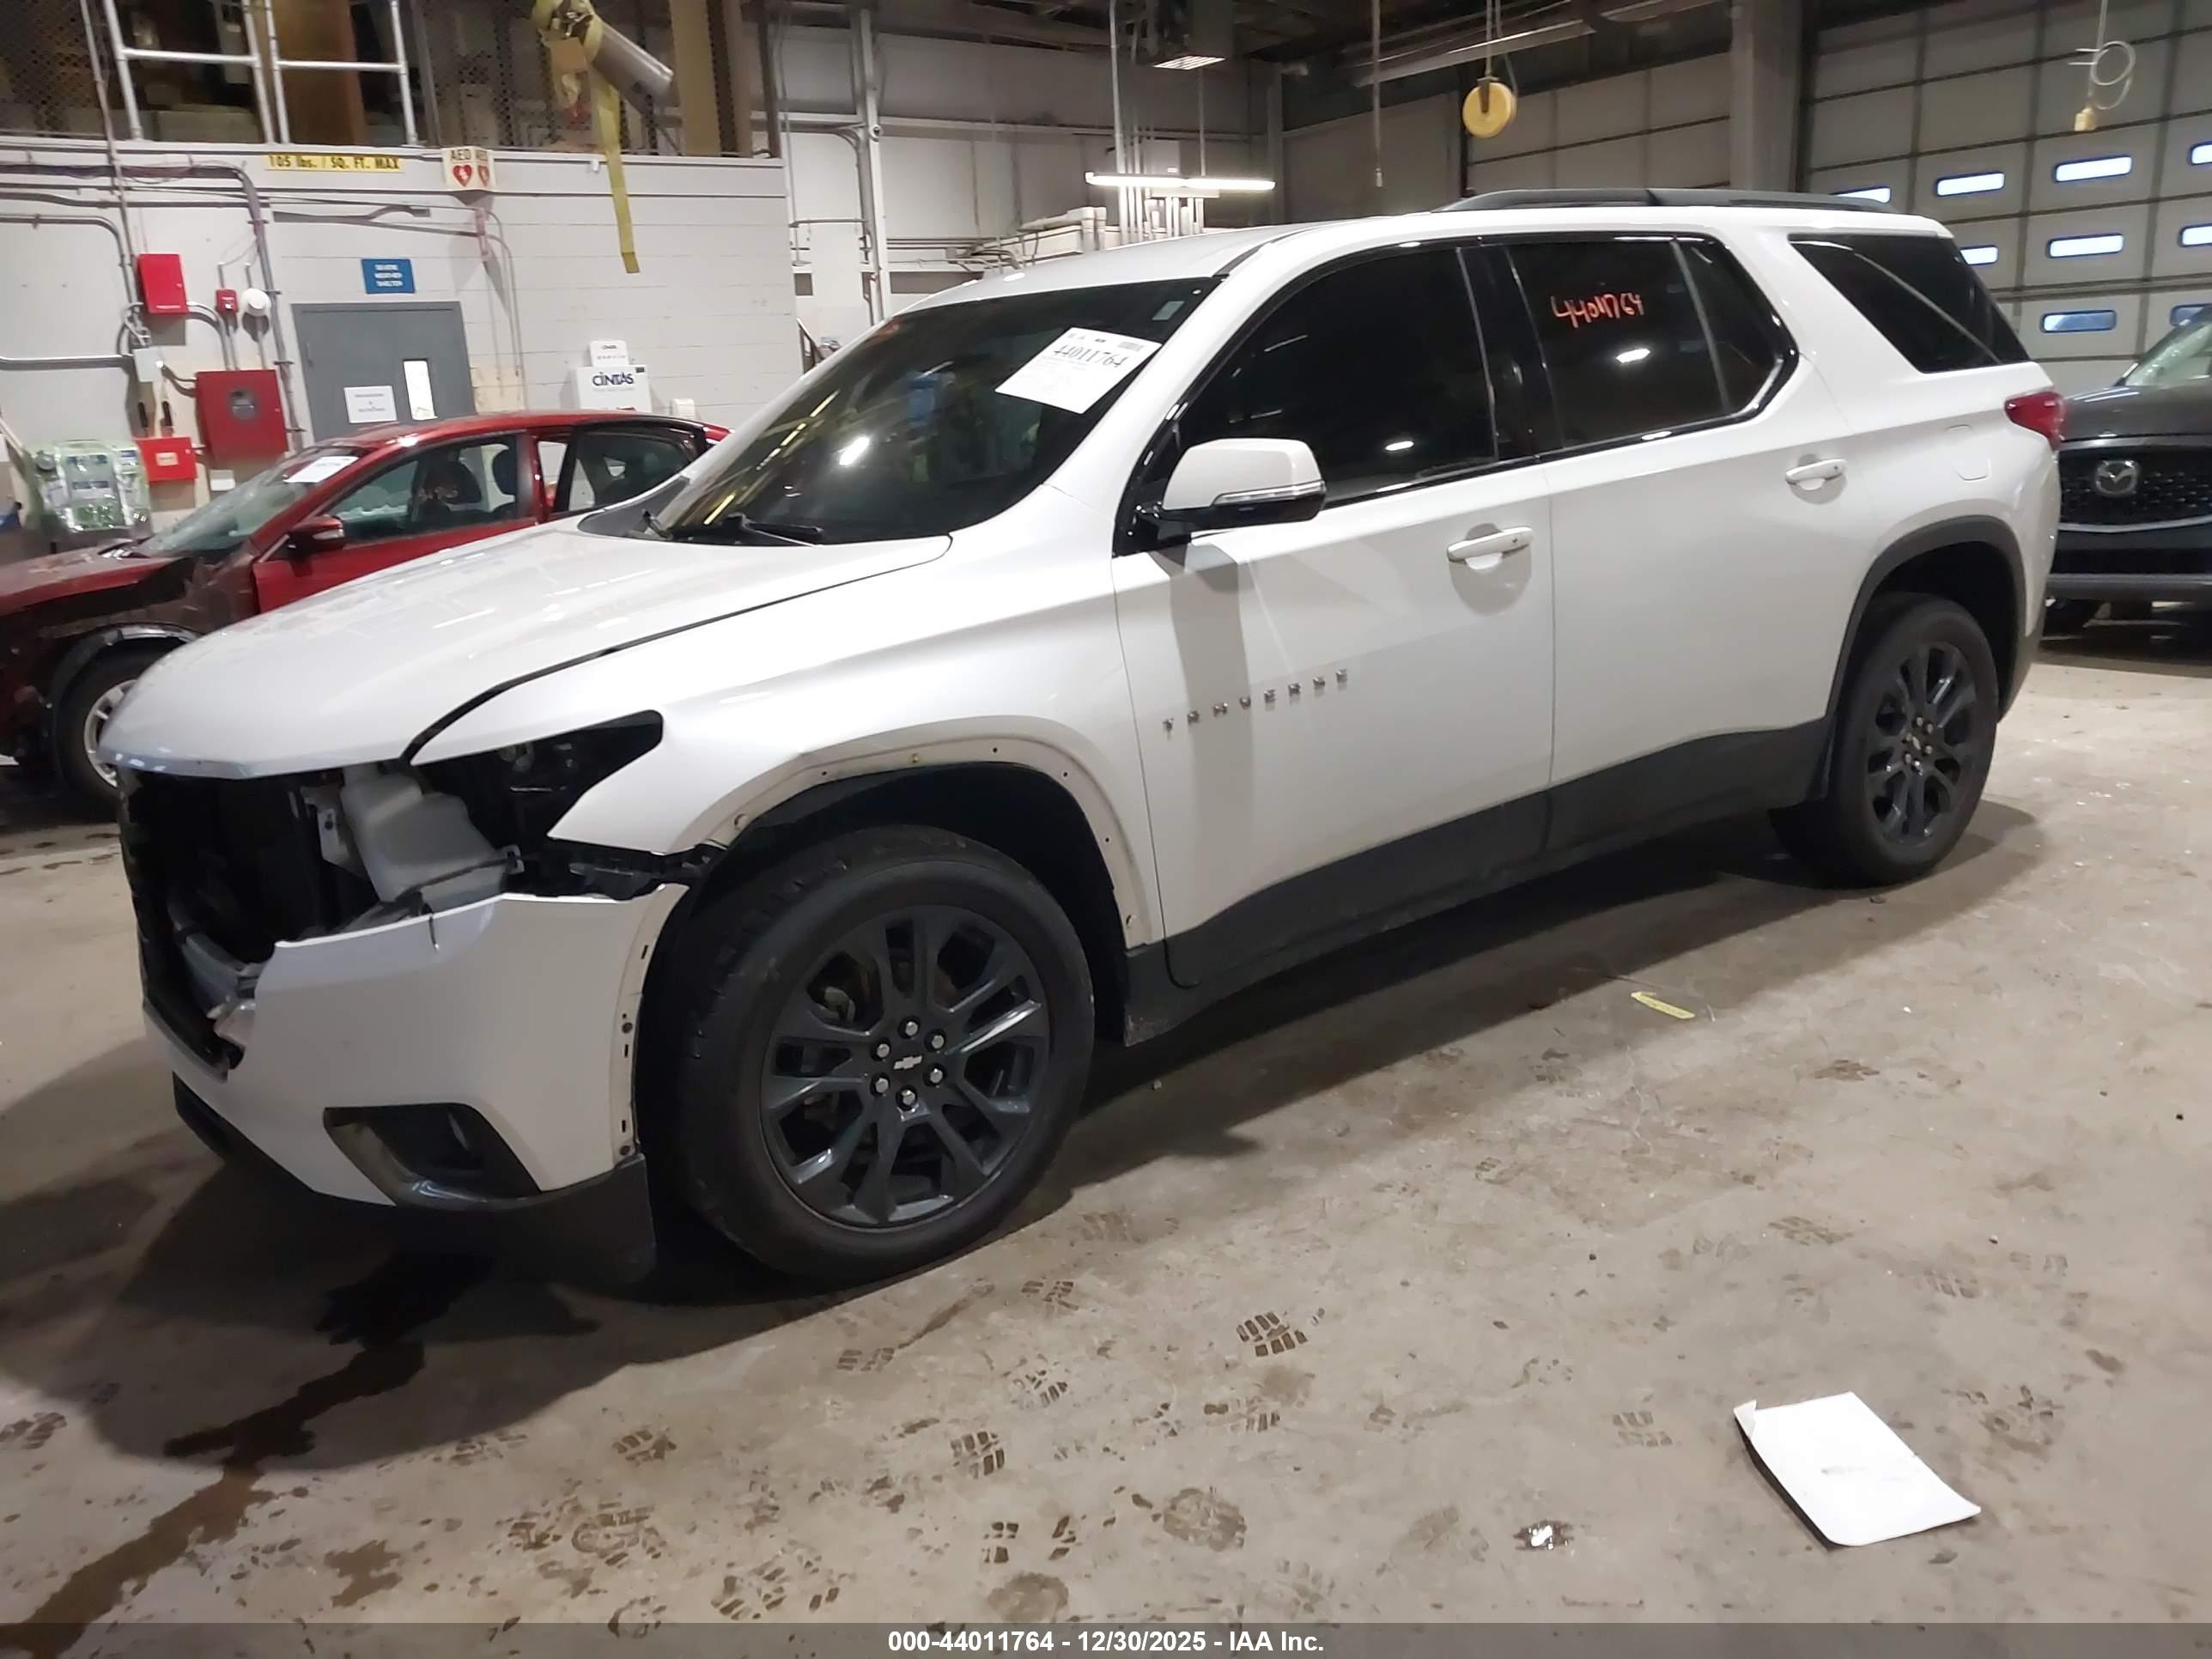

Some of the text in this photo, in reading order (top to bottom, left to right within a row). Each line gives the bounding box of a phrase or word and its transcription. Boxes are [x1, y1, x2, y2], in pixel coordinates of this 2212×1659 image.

[269, 155, 290, 167] 105
[374, 157, 399, 169] MAX
[450, 149, 471, 161] AED
[1054, 344, 1129, 368] 44011764
